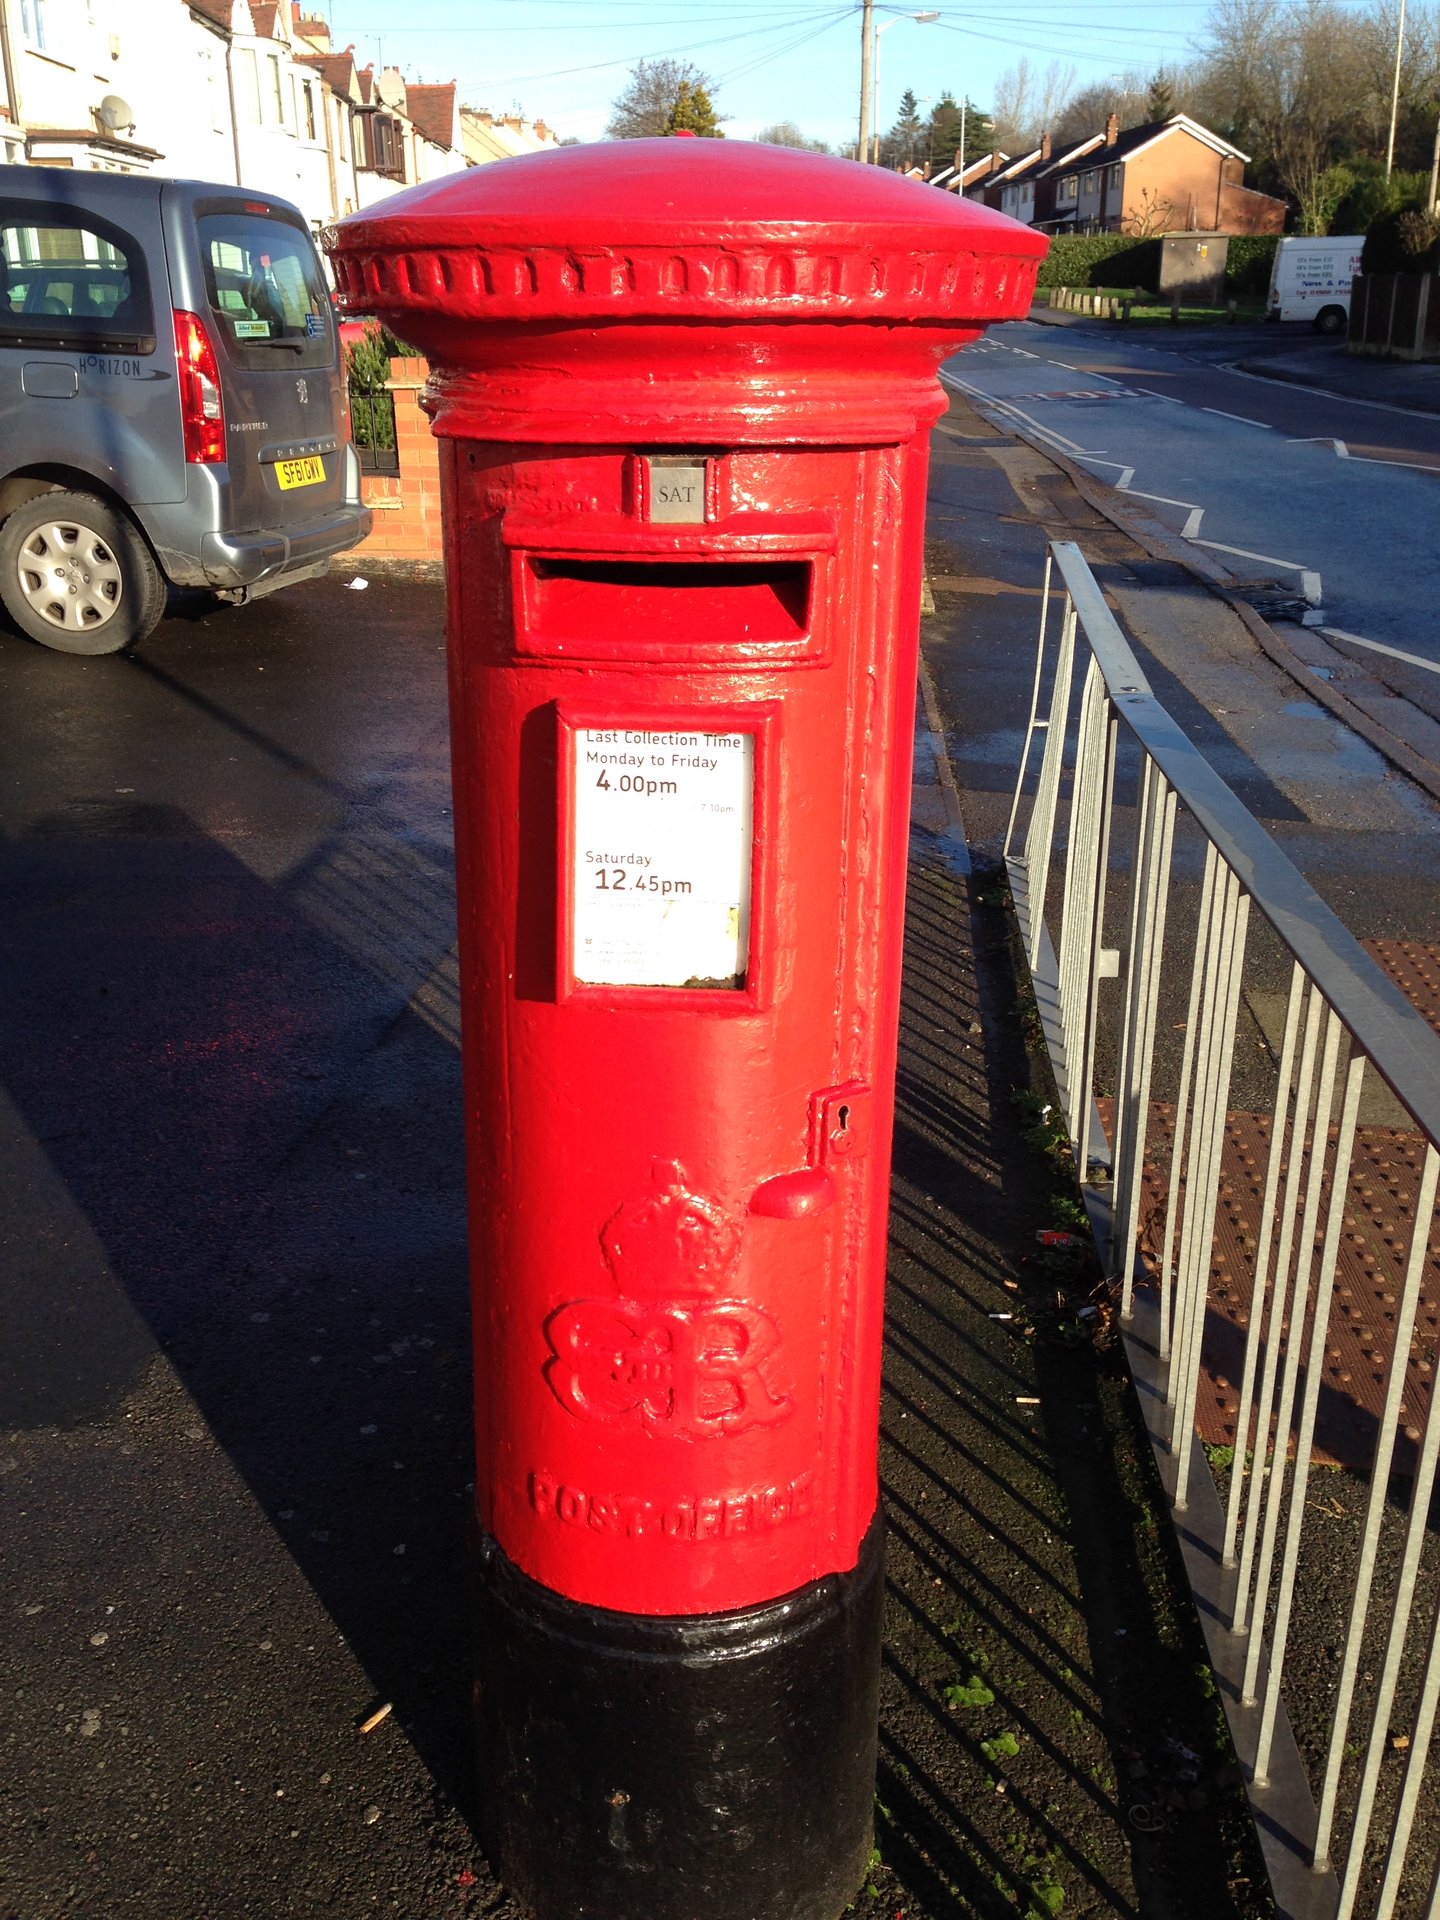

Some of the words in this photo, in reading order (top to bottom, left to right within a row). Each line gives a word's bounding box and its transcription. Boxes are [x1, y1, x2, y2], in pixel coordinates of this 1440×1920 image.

[658, 486, 695, 504] SAT
[586, 730, 618, 744] Last
[624, 731, 698, 747] Collection
[703, 733, 741, 749] Time
[586, 751, 645, 767] Monday
[650, 754, 665, 766] to
[671, 754, 718, 771] Friday
[596, 769, 677, 796] 4.00pm
[585, 851, 652, 868] Saturday
[595, 868, 692, 895] 12.45pm
[526, 1470, 652, 1539] POST
[659, 1470, 816, 1542] OFFICE
